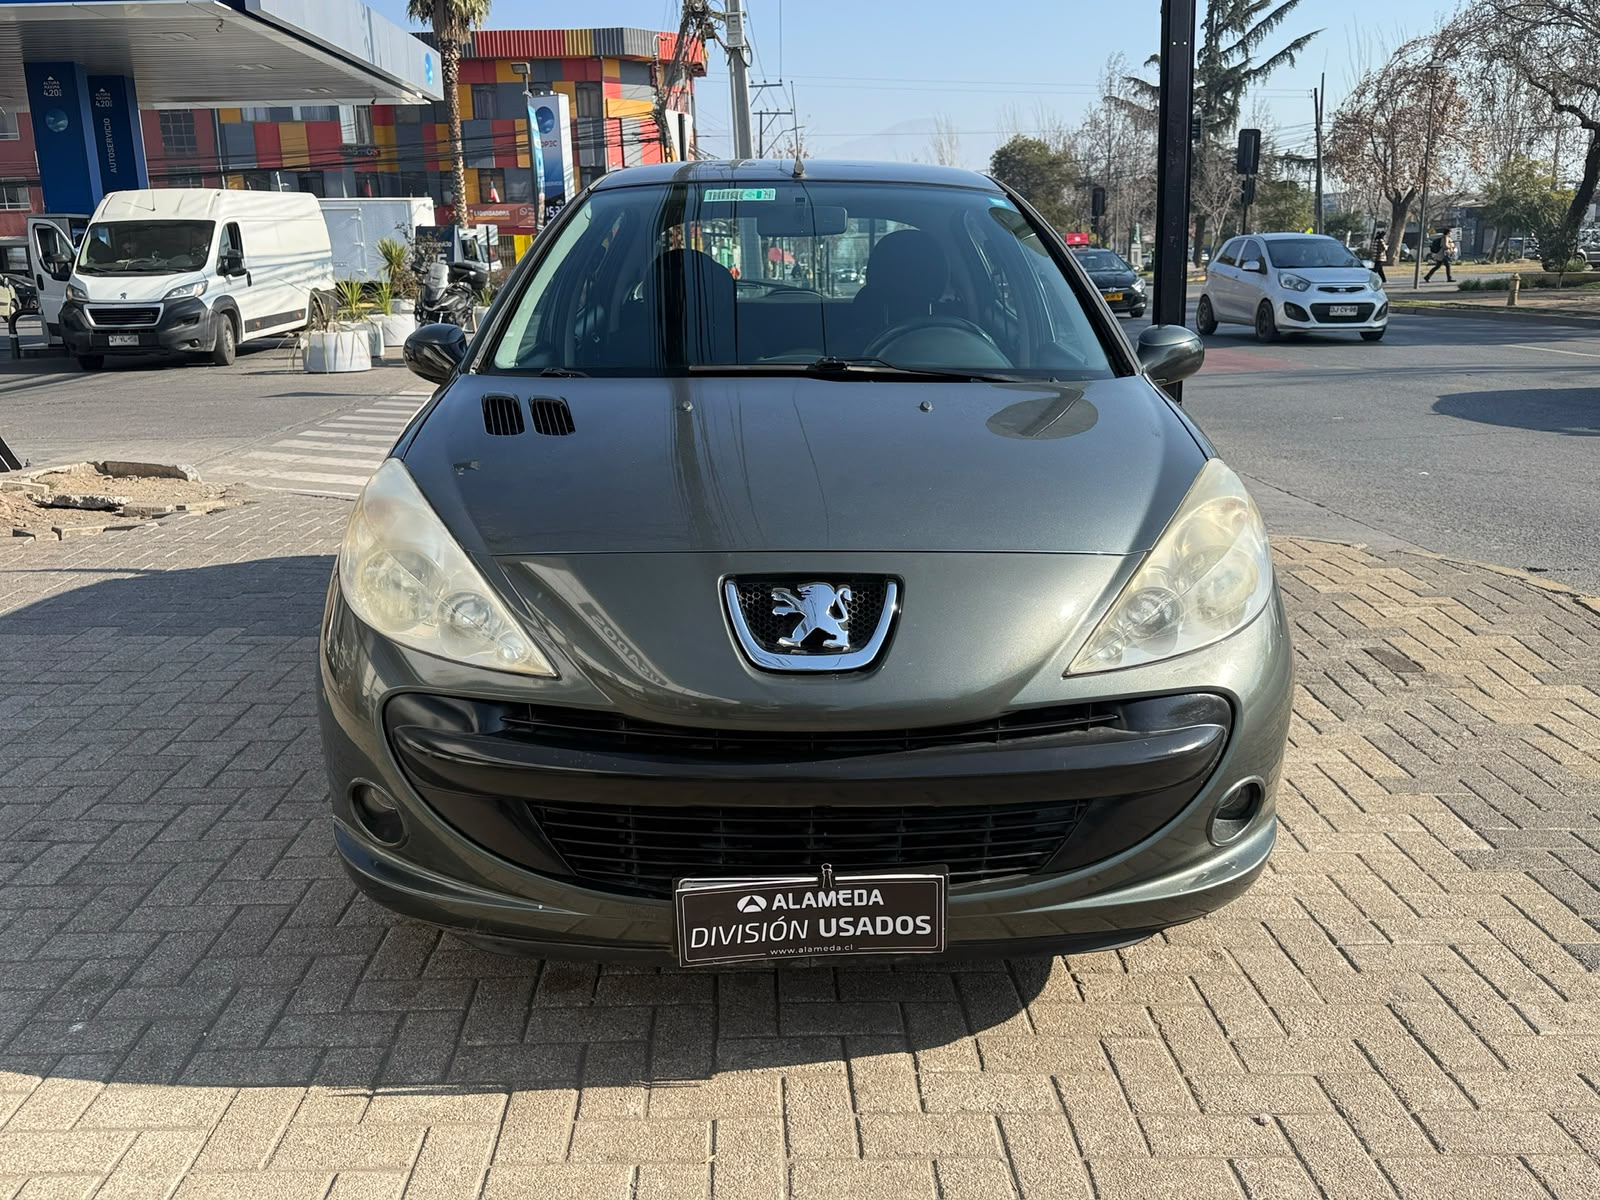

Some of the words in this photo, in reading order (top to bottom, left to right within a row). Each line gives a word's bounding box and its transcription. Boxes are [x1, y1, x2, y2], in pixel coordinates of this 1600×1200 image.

[103, 118, 117, 173] AUTOSERVICIO
[771, 888, 884, 911] ALAMEDA
[690, 916, 809, 949] DIVISIÓN
[818, 915, 932, 938] USADOS
[769, 944, 853, 955] www.alameda.cl
